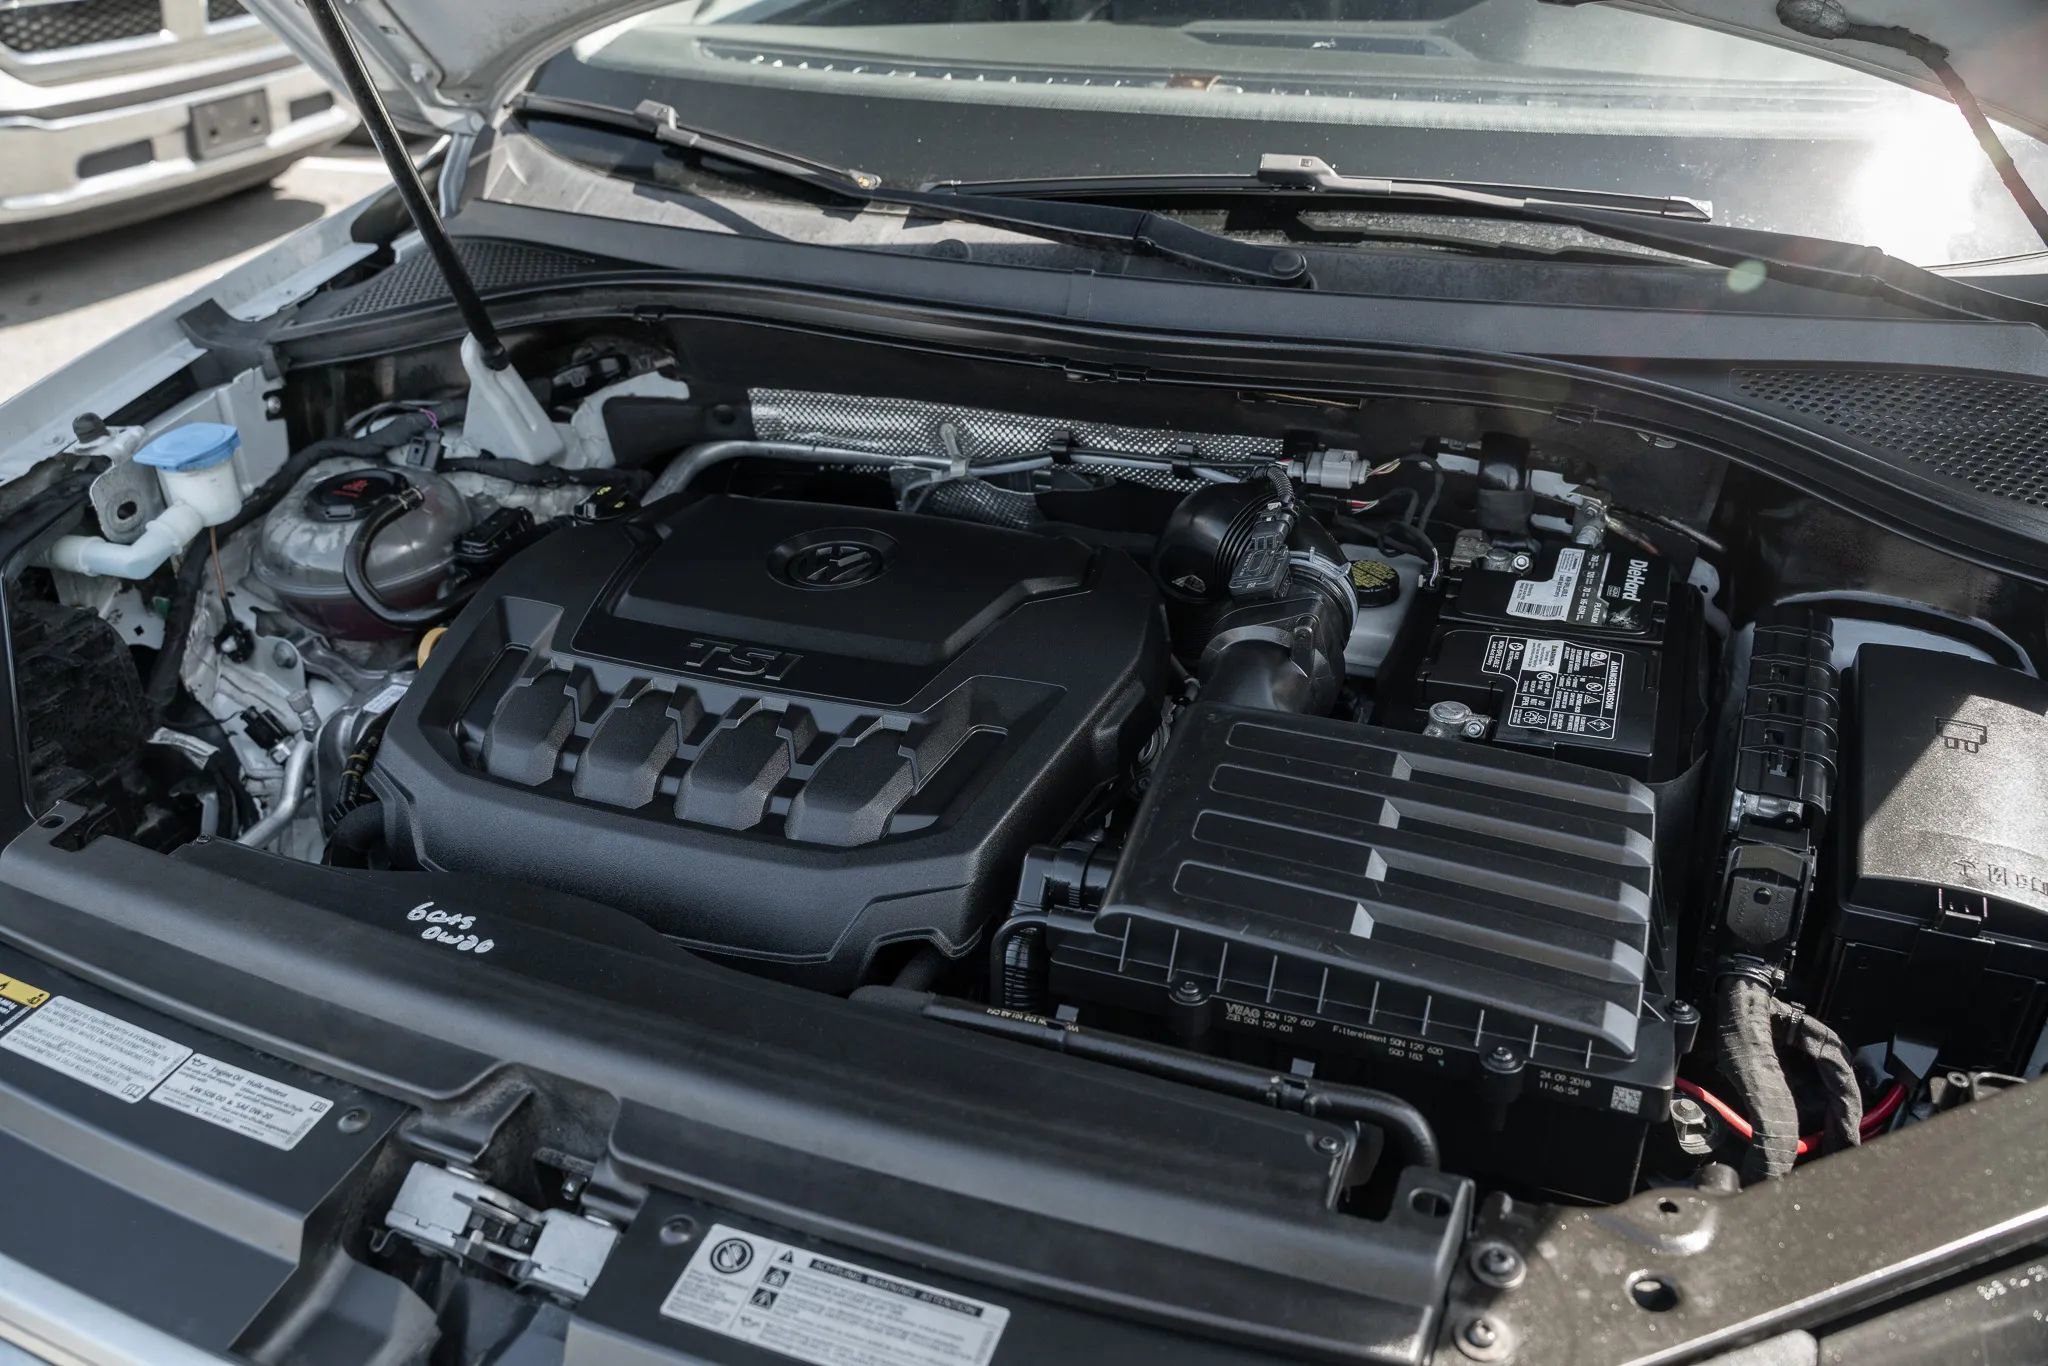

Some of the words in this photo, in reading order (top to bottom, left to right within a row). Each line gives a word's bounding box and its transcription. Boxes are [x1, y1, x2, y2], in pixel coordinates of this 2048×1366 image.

[1622, 559, 1648, 602] DieHard
[1590, 602, 1602, 624] PLATINUM
[684, 638, 804, 681] TSI
[1492, 640, 1504, 668] NON-SPILLABLE
[1604, 664, 1618, 710] DANGER/POISON
[1262, 1020, 1276, 1029] 129
[1279, 1024, 1293, 1033] 601
[1284, 1014, 1298, 1024] 129
[1300, 1018, 1316, 1028] 607
[1332, 1025, 1386, 1044] Filterelement
[1410, 1042, 1424, 1051] 129
[1428, 1046, 1444, 1056] 620
[211, 1066, 234, 1078] Engine
